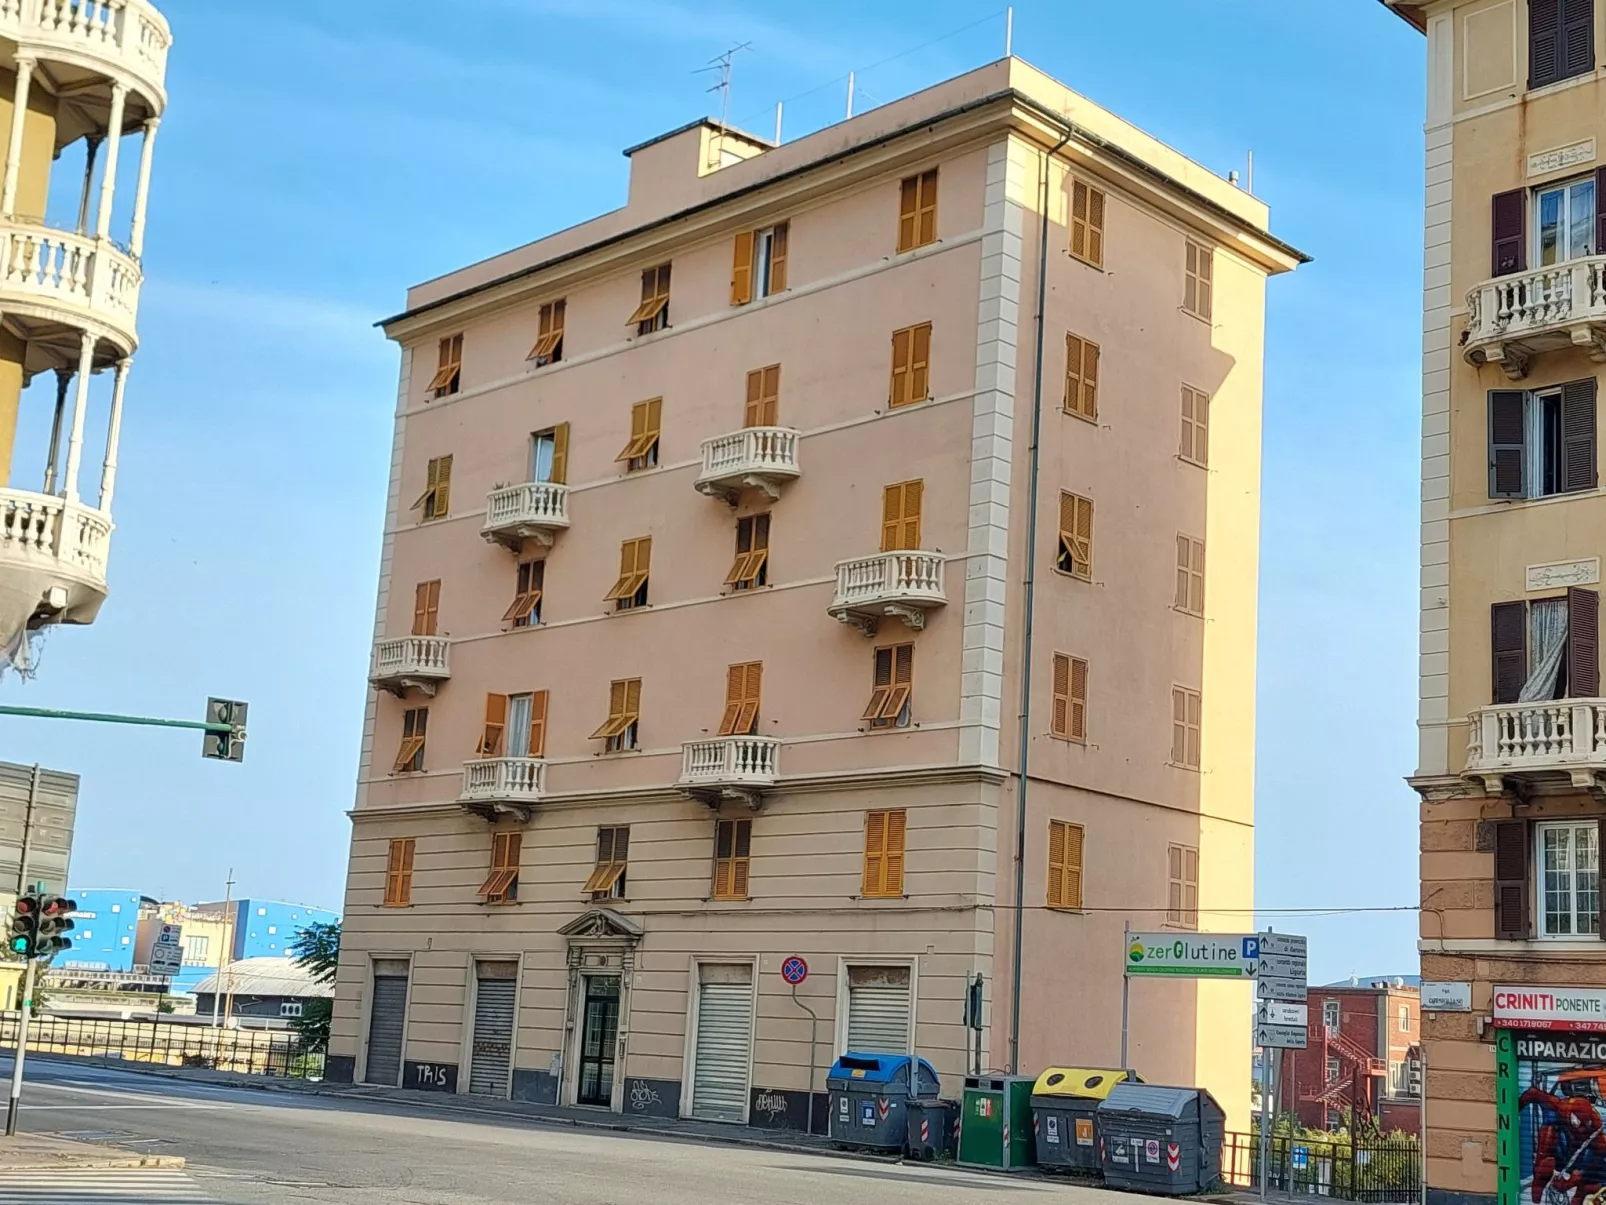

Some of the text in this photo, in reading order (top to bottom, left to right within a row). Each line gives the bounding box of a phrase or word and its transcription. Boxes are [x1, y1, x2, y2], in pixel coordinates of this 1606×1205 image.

[1495, 993, 1601, 1013] CRINITI PONENTE
[1498, 1036, 1510, 1205] CRINITI
